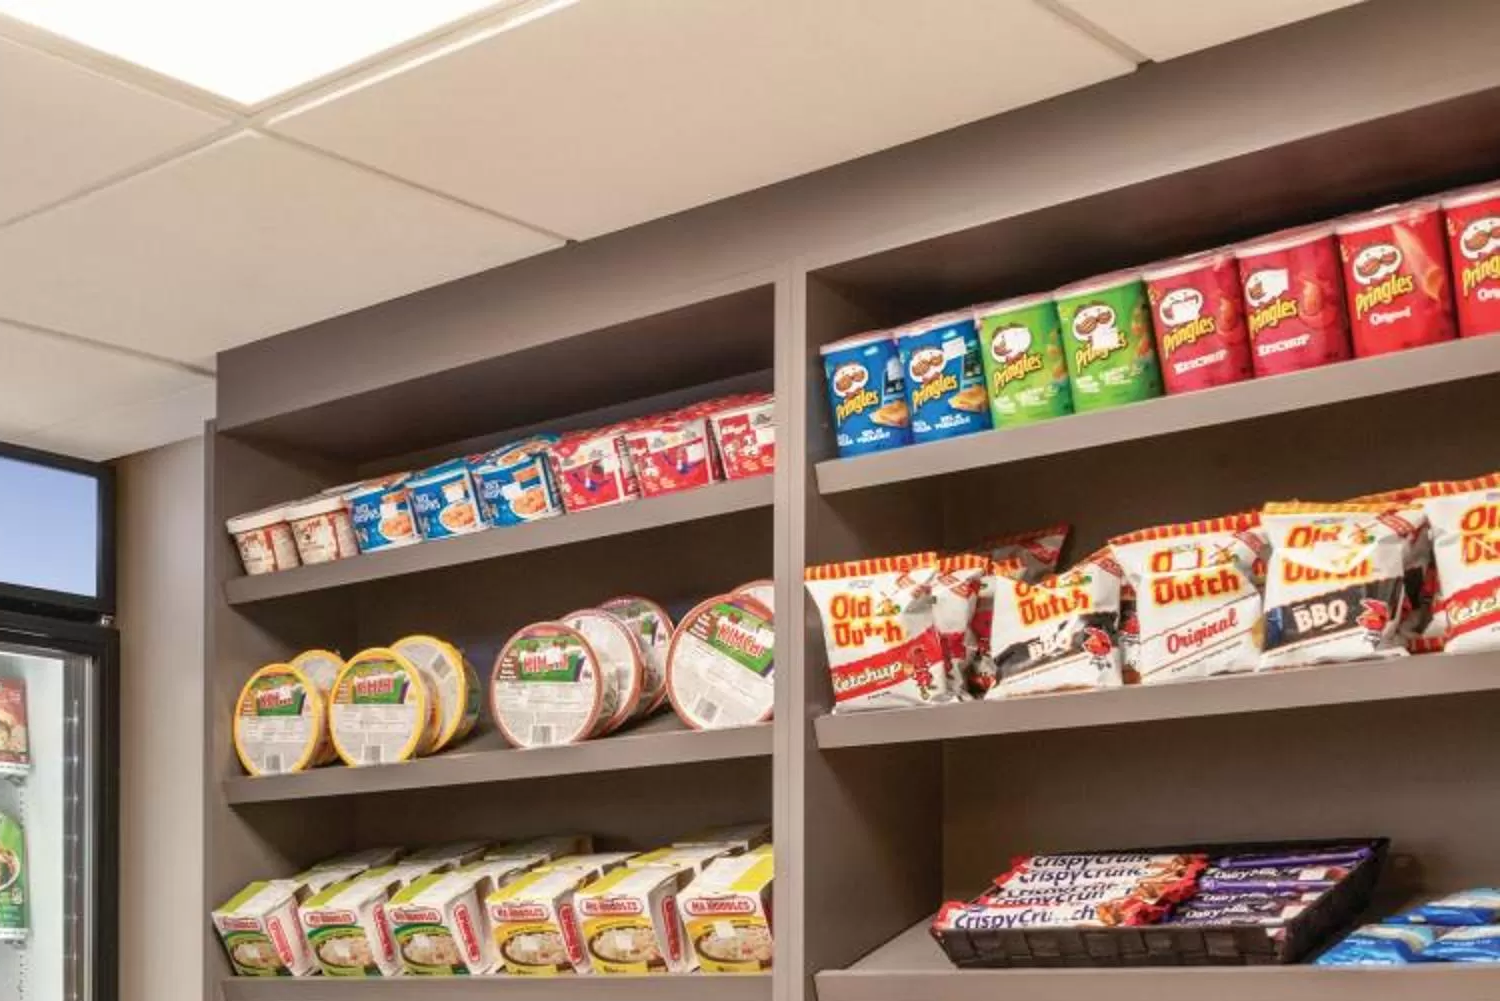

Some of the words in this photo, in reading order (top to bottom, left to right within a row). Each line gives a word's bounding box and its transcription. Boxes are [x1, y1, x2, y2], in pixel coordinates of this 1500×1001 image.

[1462, 254, 1500, 296] Pring
[1355, 274, 1414, 318] Pringles
[1249, 298, 1298, 338] Pringles
[1163, 316, 1215, 359] Pringles
[912, 374, 958, 409] Pringles
[993, 353, 1043, 393] Pringles
[836, 389, 878, 426] Pringles
[1153, 571, 1239, 605] Dutch
[829, 594, 872, 621] Old
[1018, 591, 1090, 627] Dutch
[1295, 600, 1349, 633] BBQ
[832, 622, 903, 648] Dutch
[1167, 607, 1238, 652] Original
